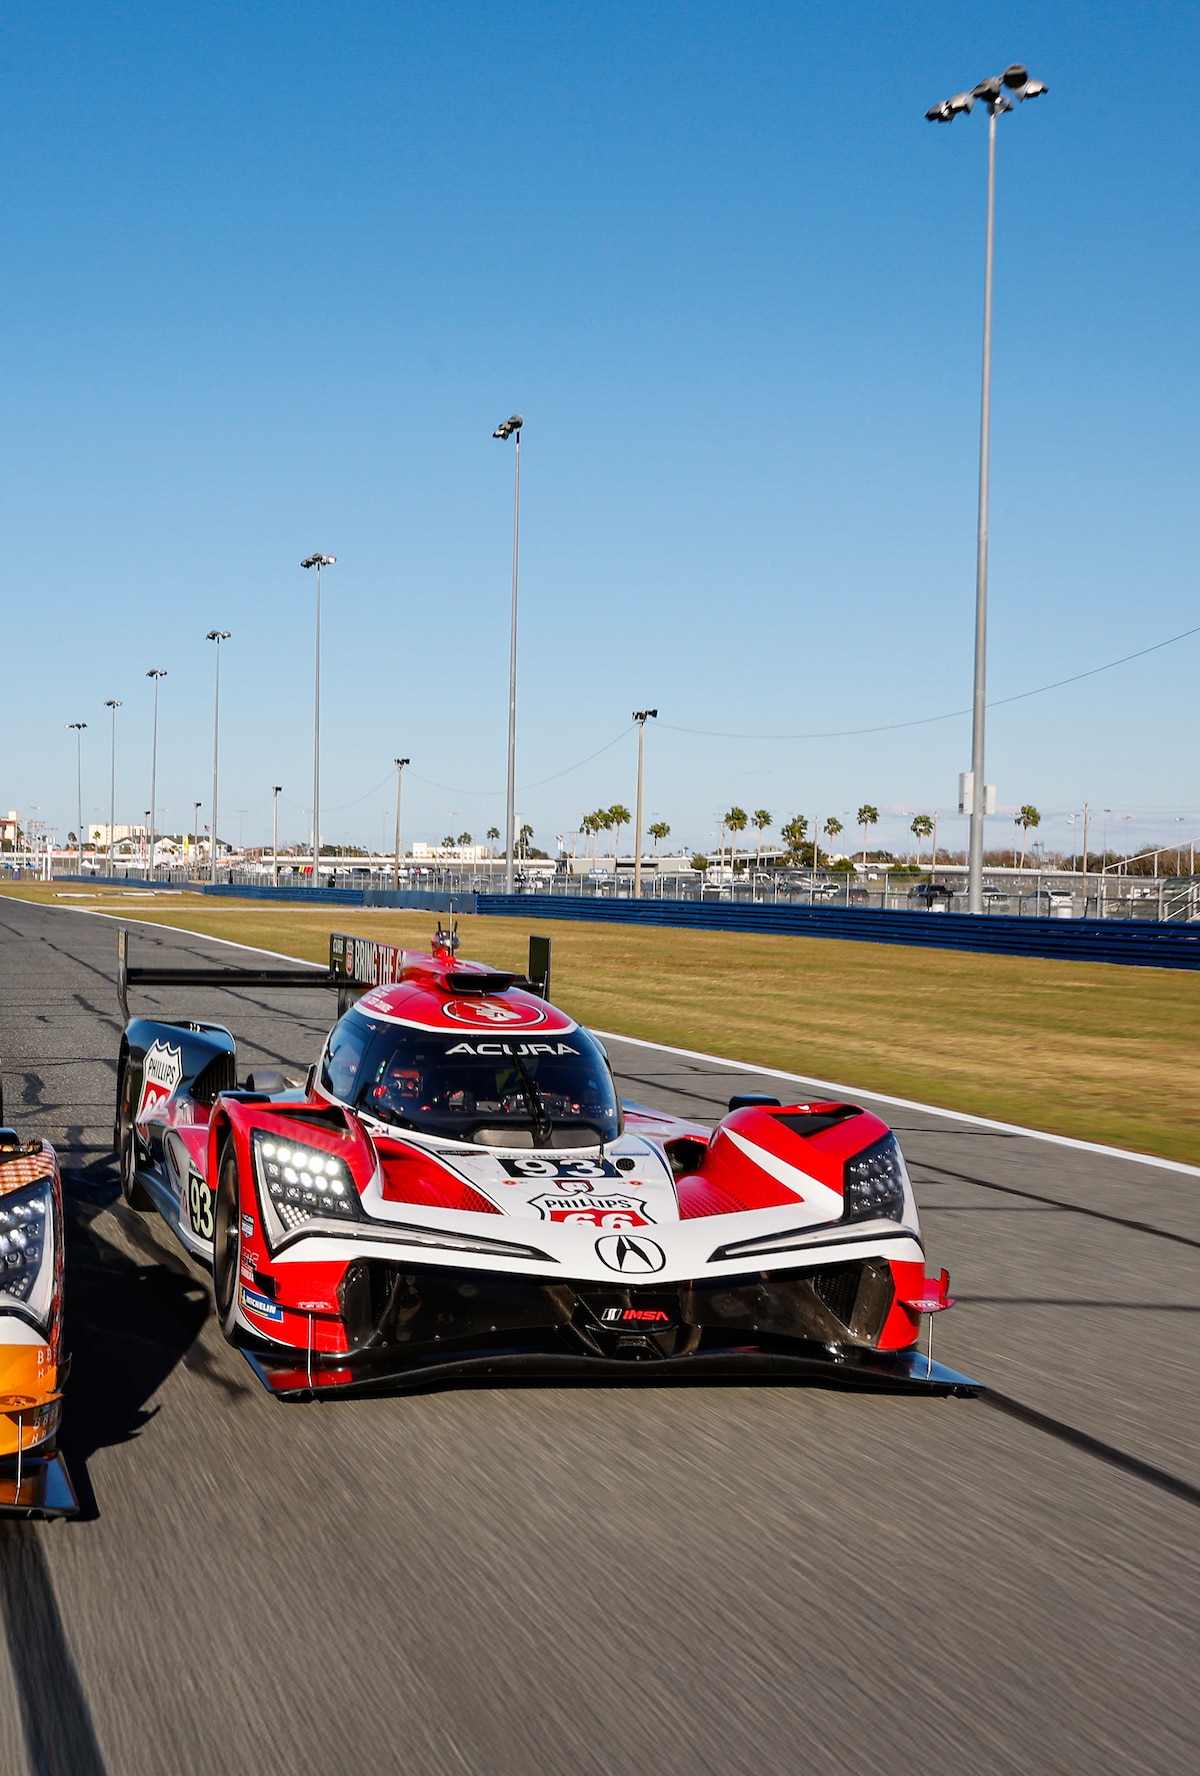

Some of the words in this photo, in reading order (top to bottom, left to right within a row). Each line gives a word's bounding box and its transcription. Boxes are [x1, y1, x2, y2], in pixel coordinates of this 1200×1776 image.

[354, 939, 378, 986] BRING
[378, 945, 395, 985] THE
[444, 1042, 581, 1056] ACURA
[147, 1057, 176, 1085] PHILLIPS
[514, 1159, 606, 1178] 93
[191, 1177, 214, 1237] 93
[544, 1198, 633, 1210] PHILLIPS
[246, 1296, 277, 1315] MICHELIN
[623, 1309, 669, 1321] IMSA
